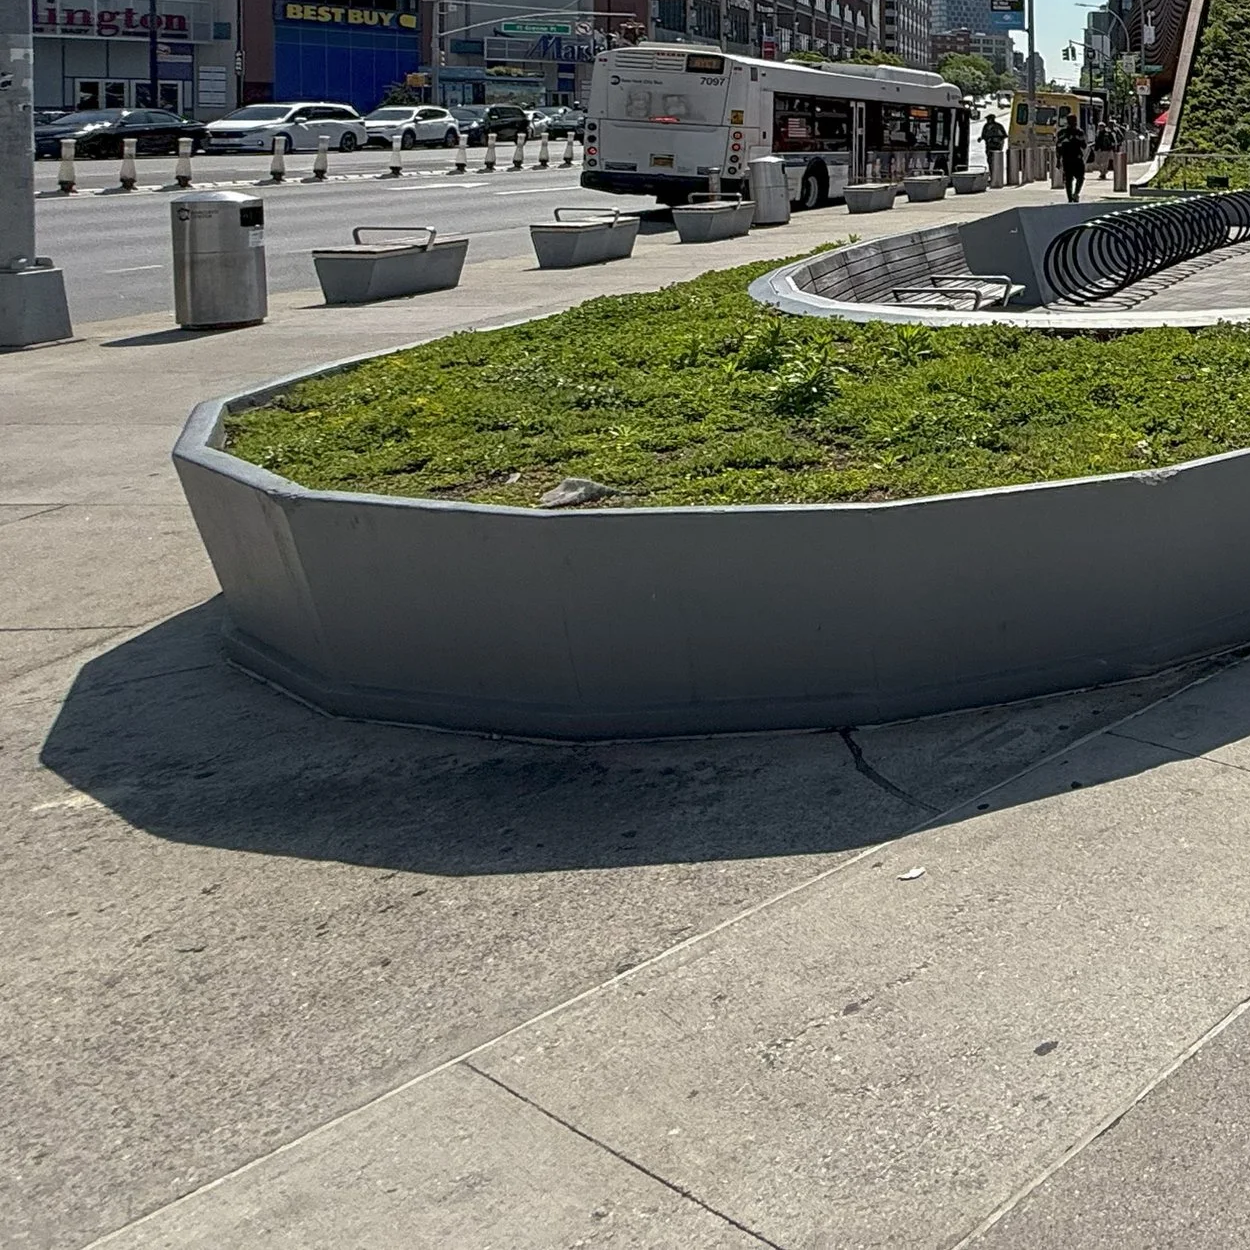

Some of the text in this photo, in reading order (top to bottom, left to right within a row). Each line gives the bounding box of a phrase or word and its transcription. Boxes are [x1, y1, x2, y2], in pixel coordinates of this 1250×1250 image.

[286, 3, 394, 26] BEST BUY
[700, 76, 725, 87] 7097
